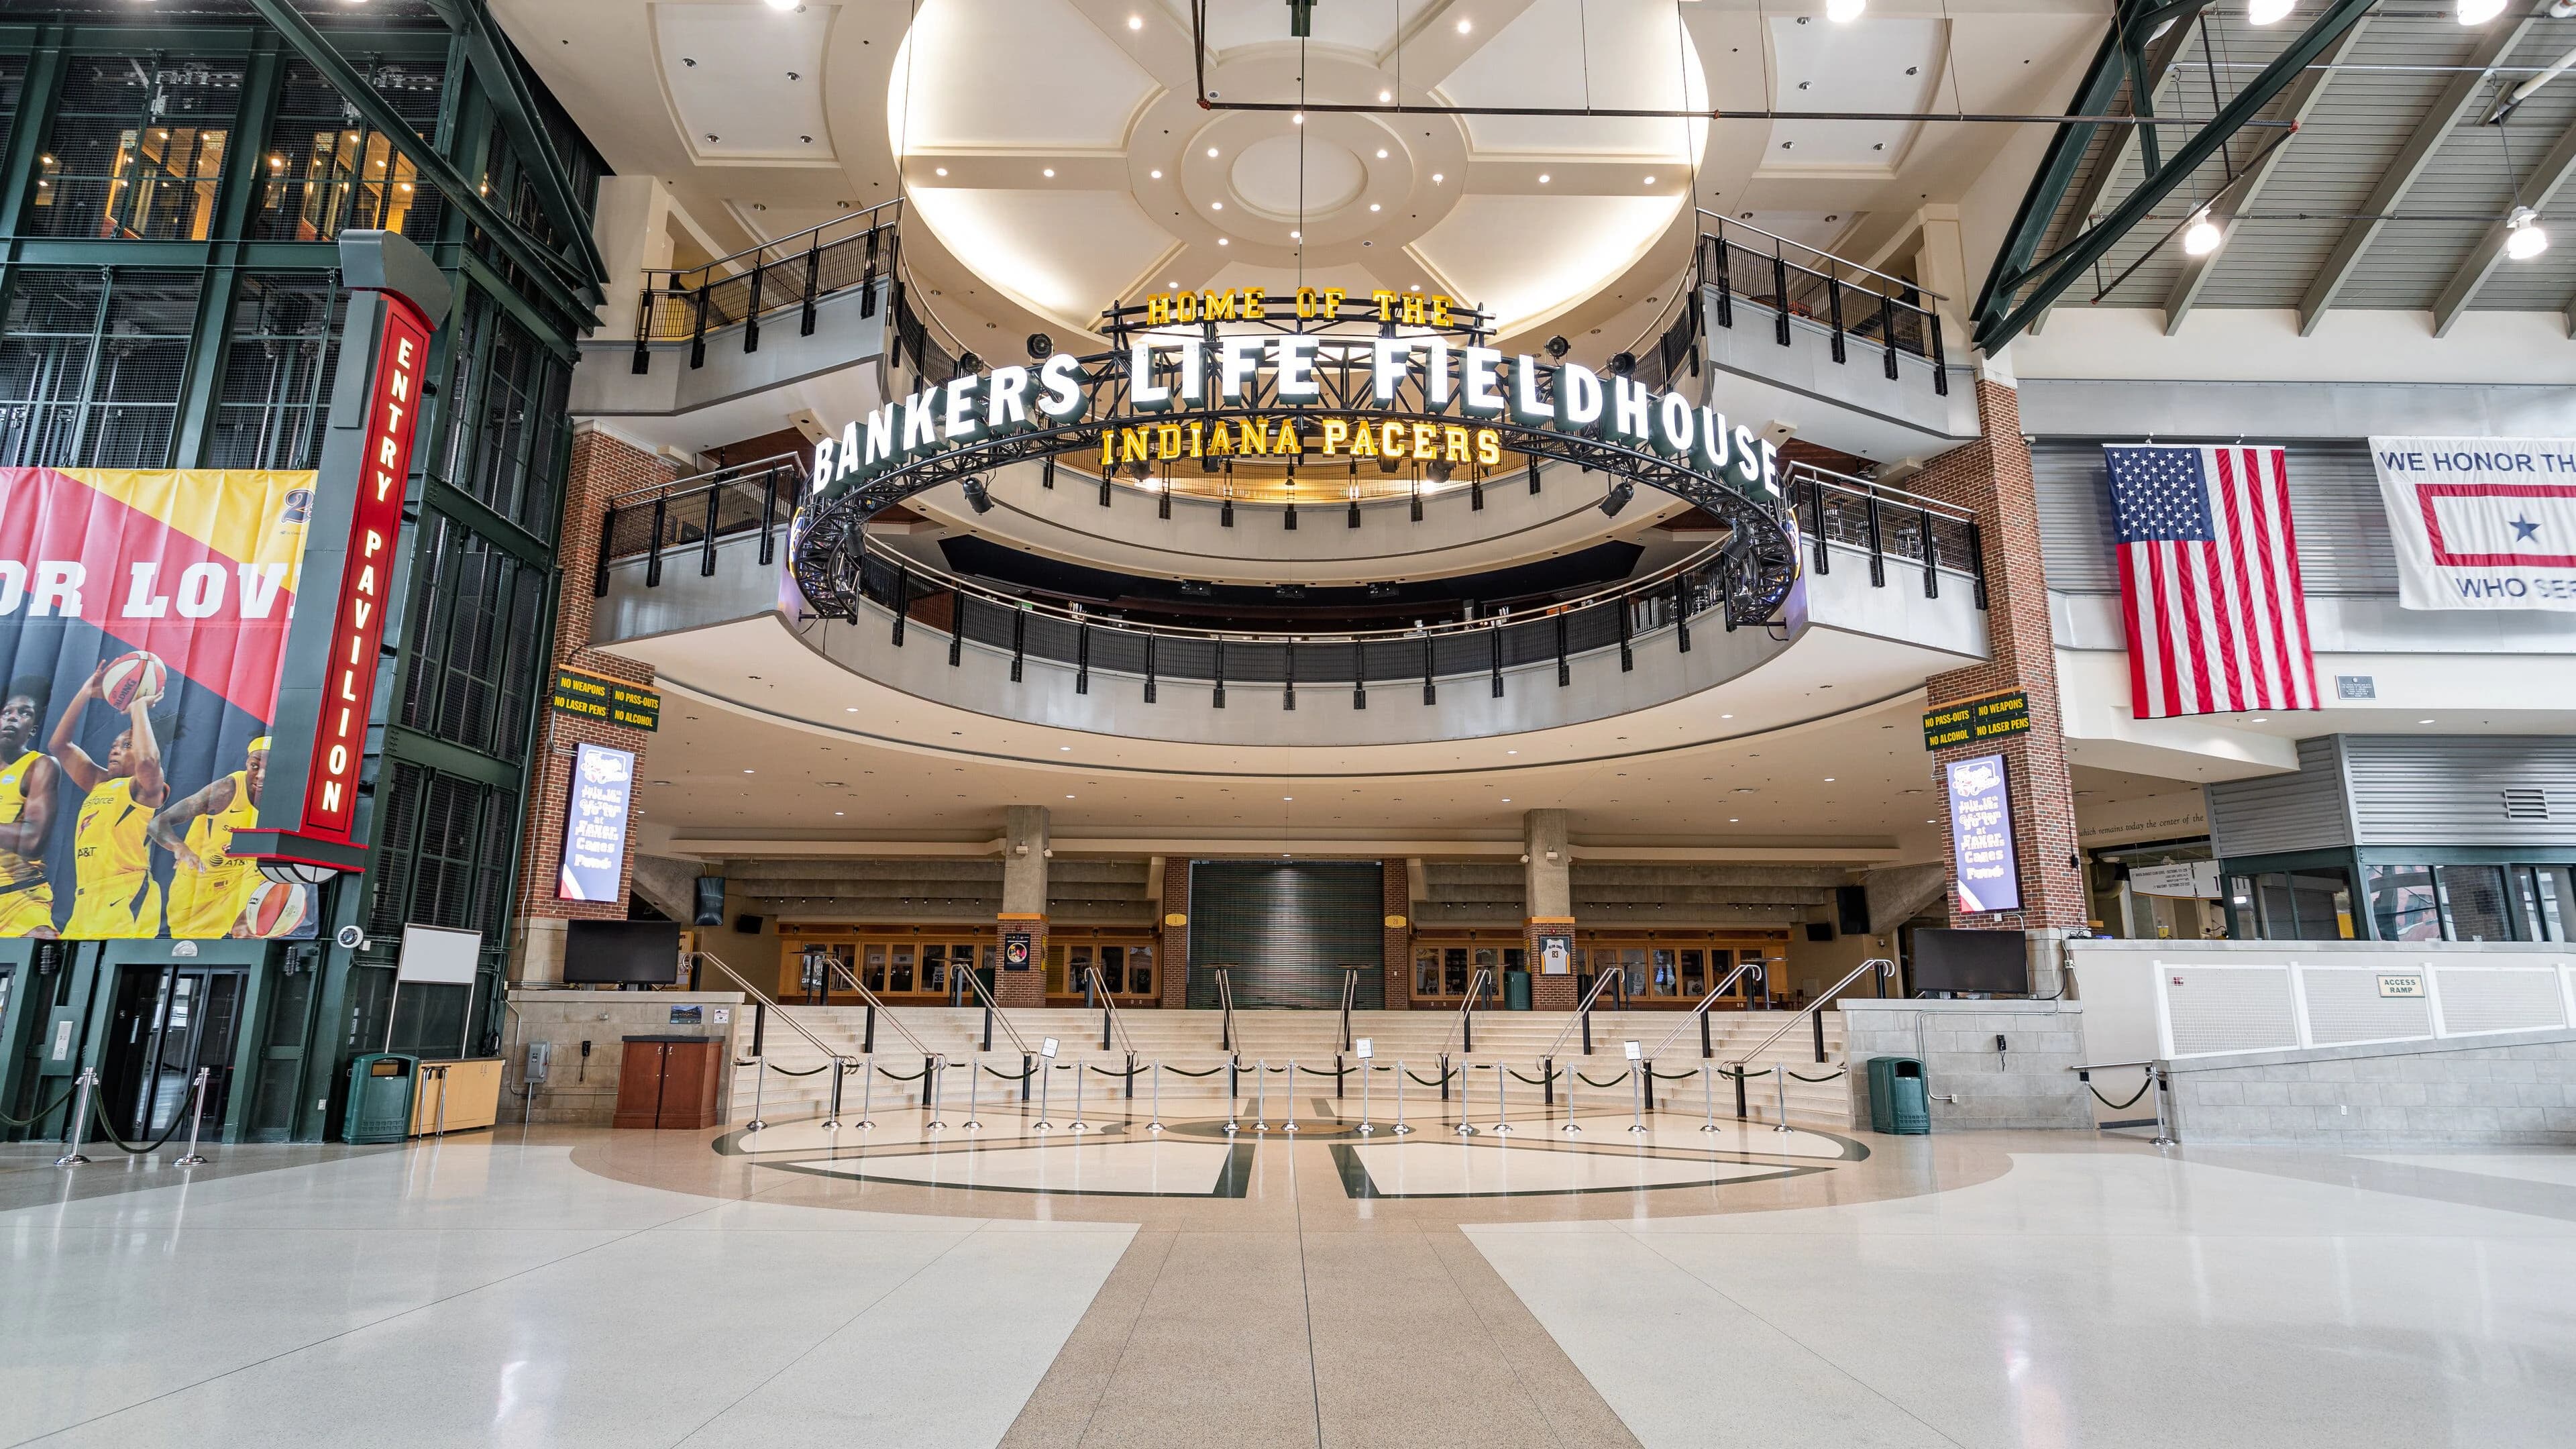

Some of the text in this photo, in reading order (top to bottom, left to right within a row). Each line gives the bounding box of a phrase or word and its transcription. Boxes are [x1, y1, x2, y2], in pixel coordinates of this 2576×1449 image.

[1147, 287, 1454, 327] HOME OF THE
[376, 337, 414, 502] ENTRY
[813, 335, 1780, 499] BANKERS LIFE FIELDHOUSE
[1102, 419, 1500, 465] INDIANA PACERS
[2379, 452, 2426, 470] WE
[2433, 452, 2536, 472] HONOR
[121, 562, 302, 619] LOV
[2455, 578, 2527, 598] WHO
[322, 529, 382, 813] PAVILION
[561, 677, 605, 696] NO WEAPONS
[554, 696, 606, 716] NO LASER PENS
[614, 690, 659, 709] NO PASS-OUTS
[1978, 698, 2023, 716] NO WEAPONS
[614, 710, 653, 727] NO ALCOHOL
[1925, 710, 1970, 728] NO PASS-OUTS
[1976, 717, 2029, 736] NO LASER PENS
[1929, 729, 1969, 746] NO ALCOHOL
[2078, 813, 2204, 837] which remains today the center of the
